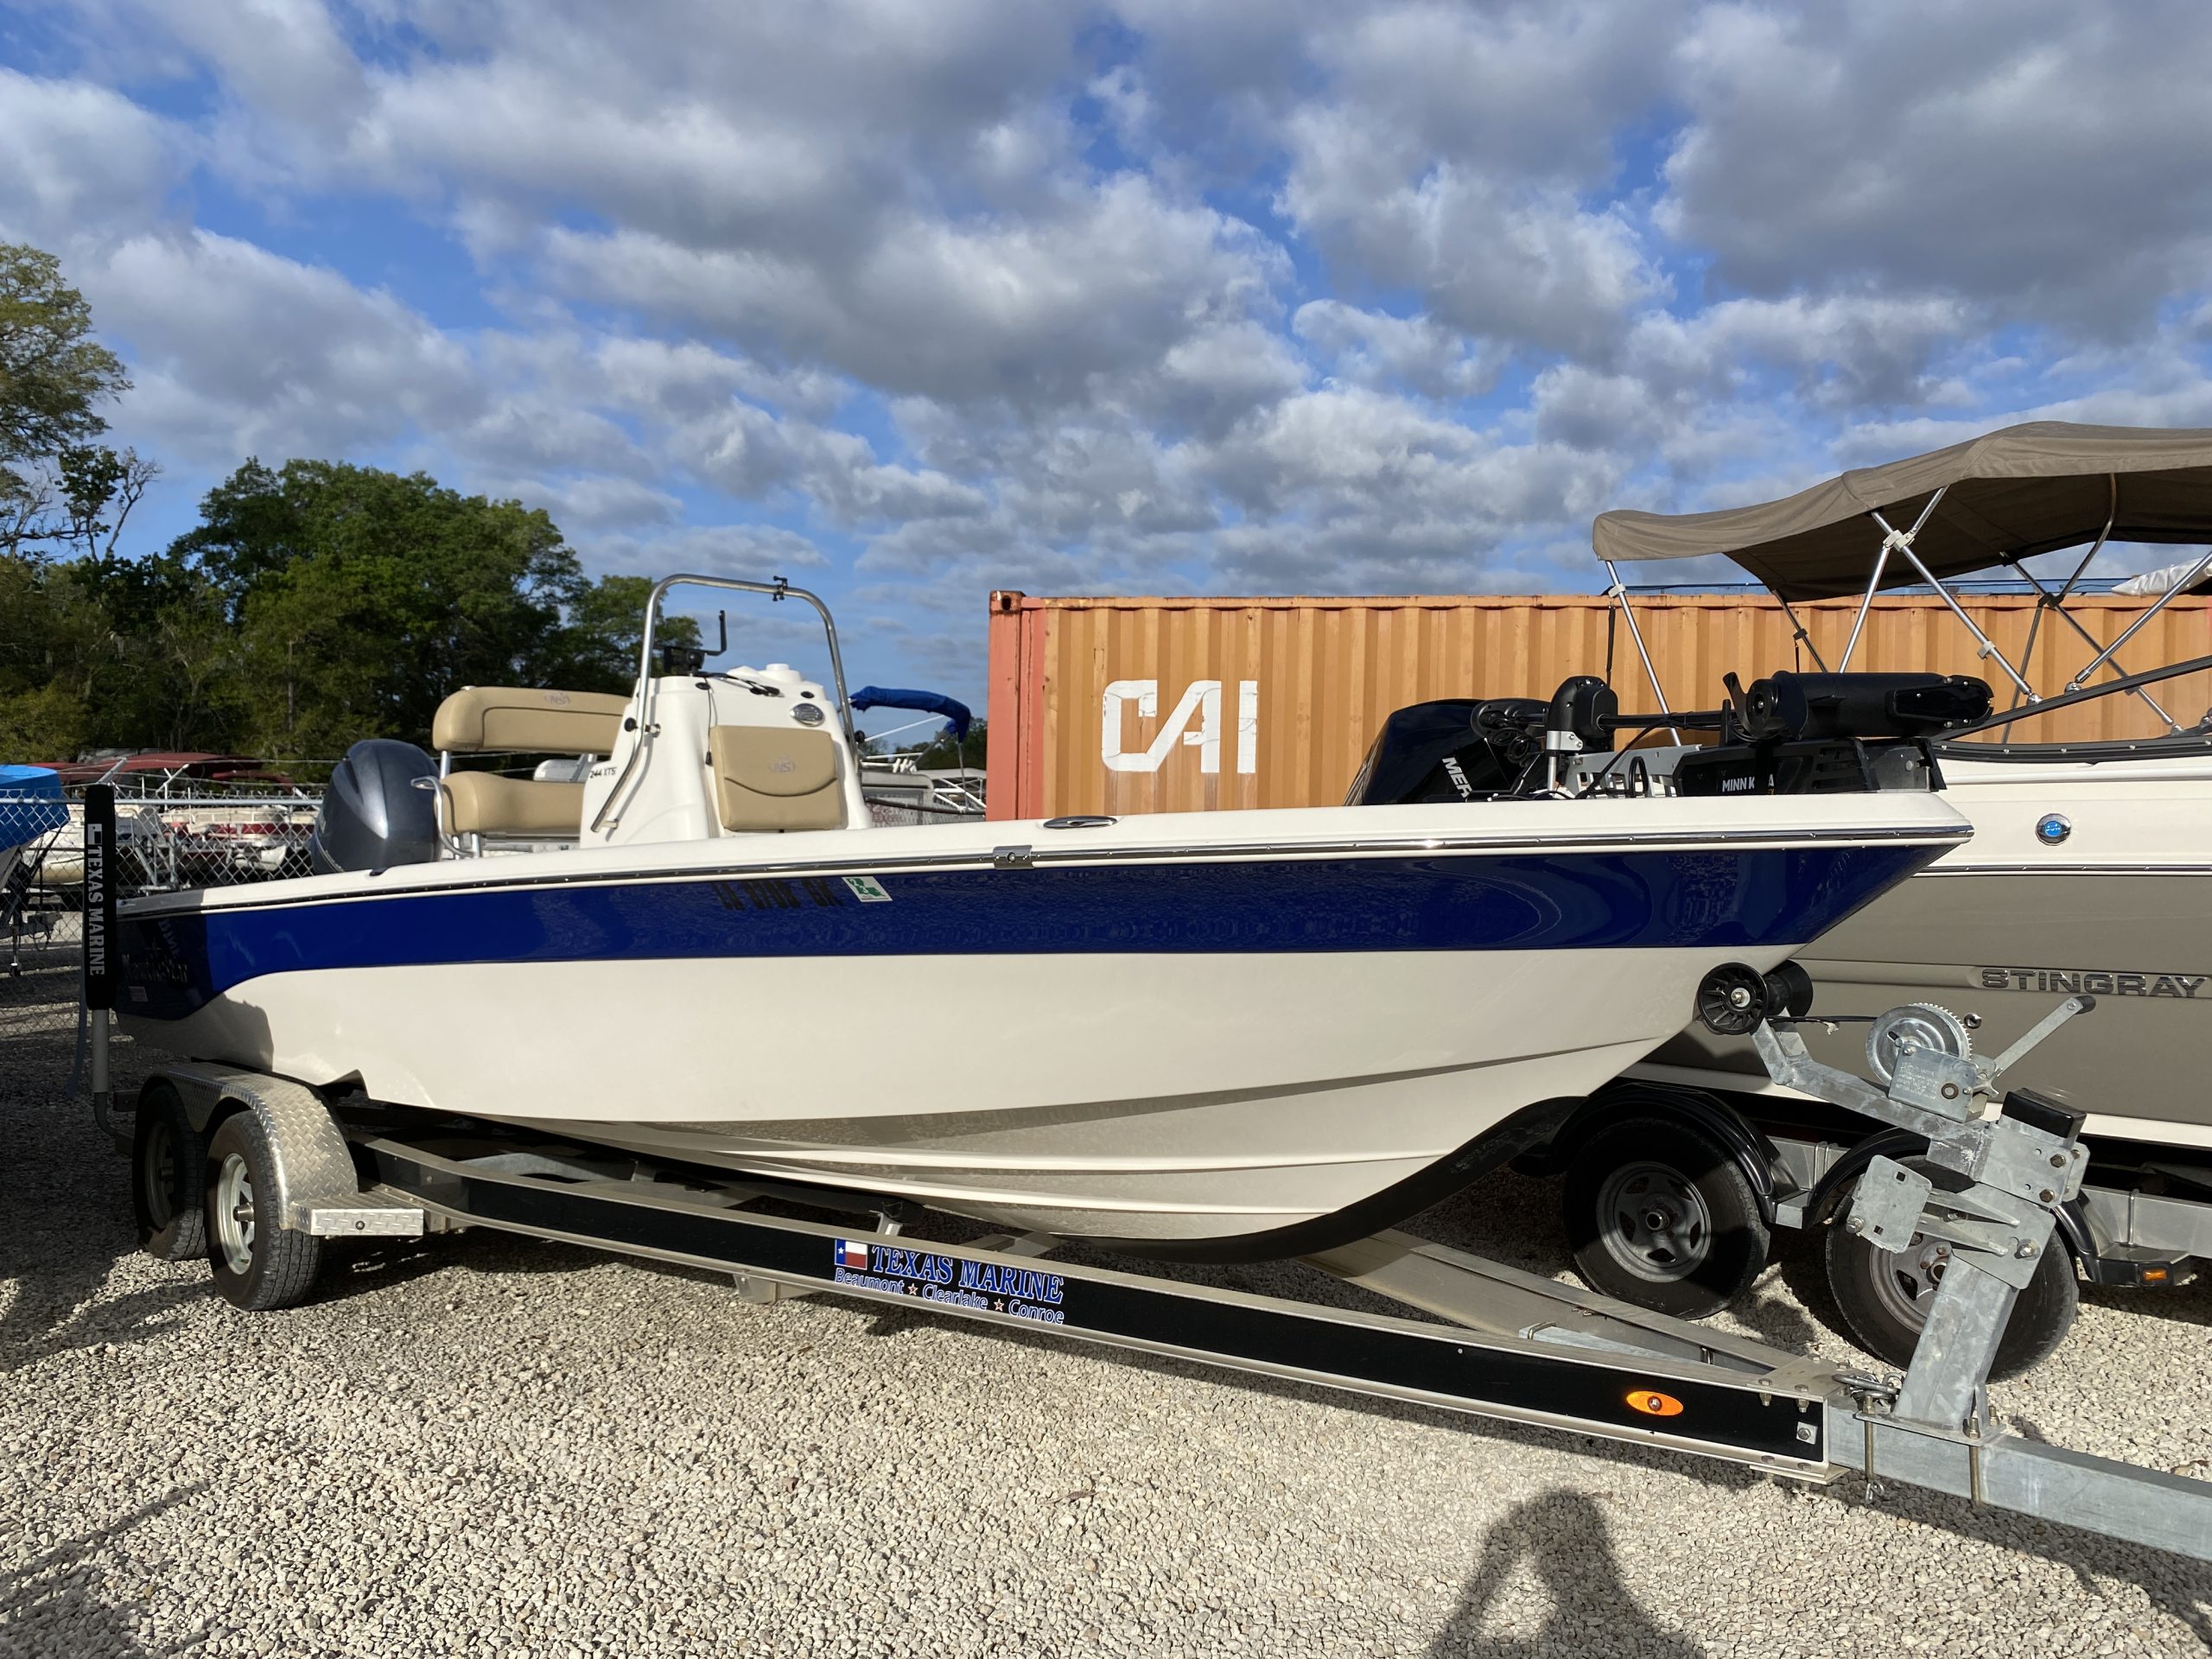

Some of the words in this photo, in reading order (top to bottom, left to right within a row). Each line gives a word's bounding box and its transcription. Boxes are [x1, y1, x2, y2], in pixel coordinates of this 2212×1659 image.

[1102, 680, 1257, 773] CAI
[1441, 757, 1473, 799] MER
[1722, 777, 1747, 792] MINN
[1748, 774, 1775, 790] KA
[87, 846, 104, 903] TEXAS
[88, 907, 105, 976] MARINE
[1981, 968, 2207, 998] STINGRAY
[835, 1267, 905, 1295] Beaumont
[922, 1283, 988, 1311] Clearlake
[1008, 1299, 1065, 1325] Conroe
[871, 1244, 953, 1284] TEXAS
[958, 1260, 1064, 1304] MARINE
